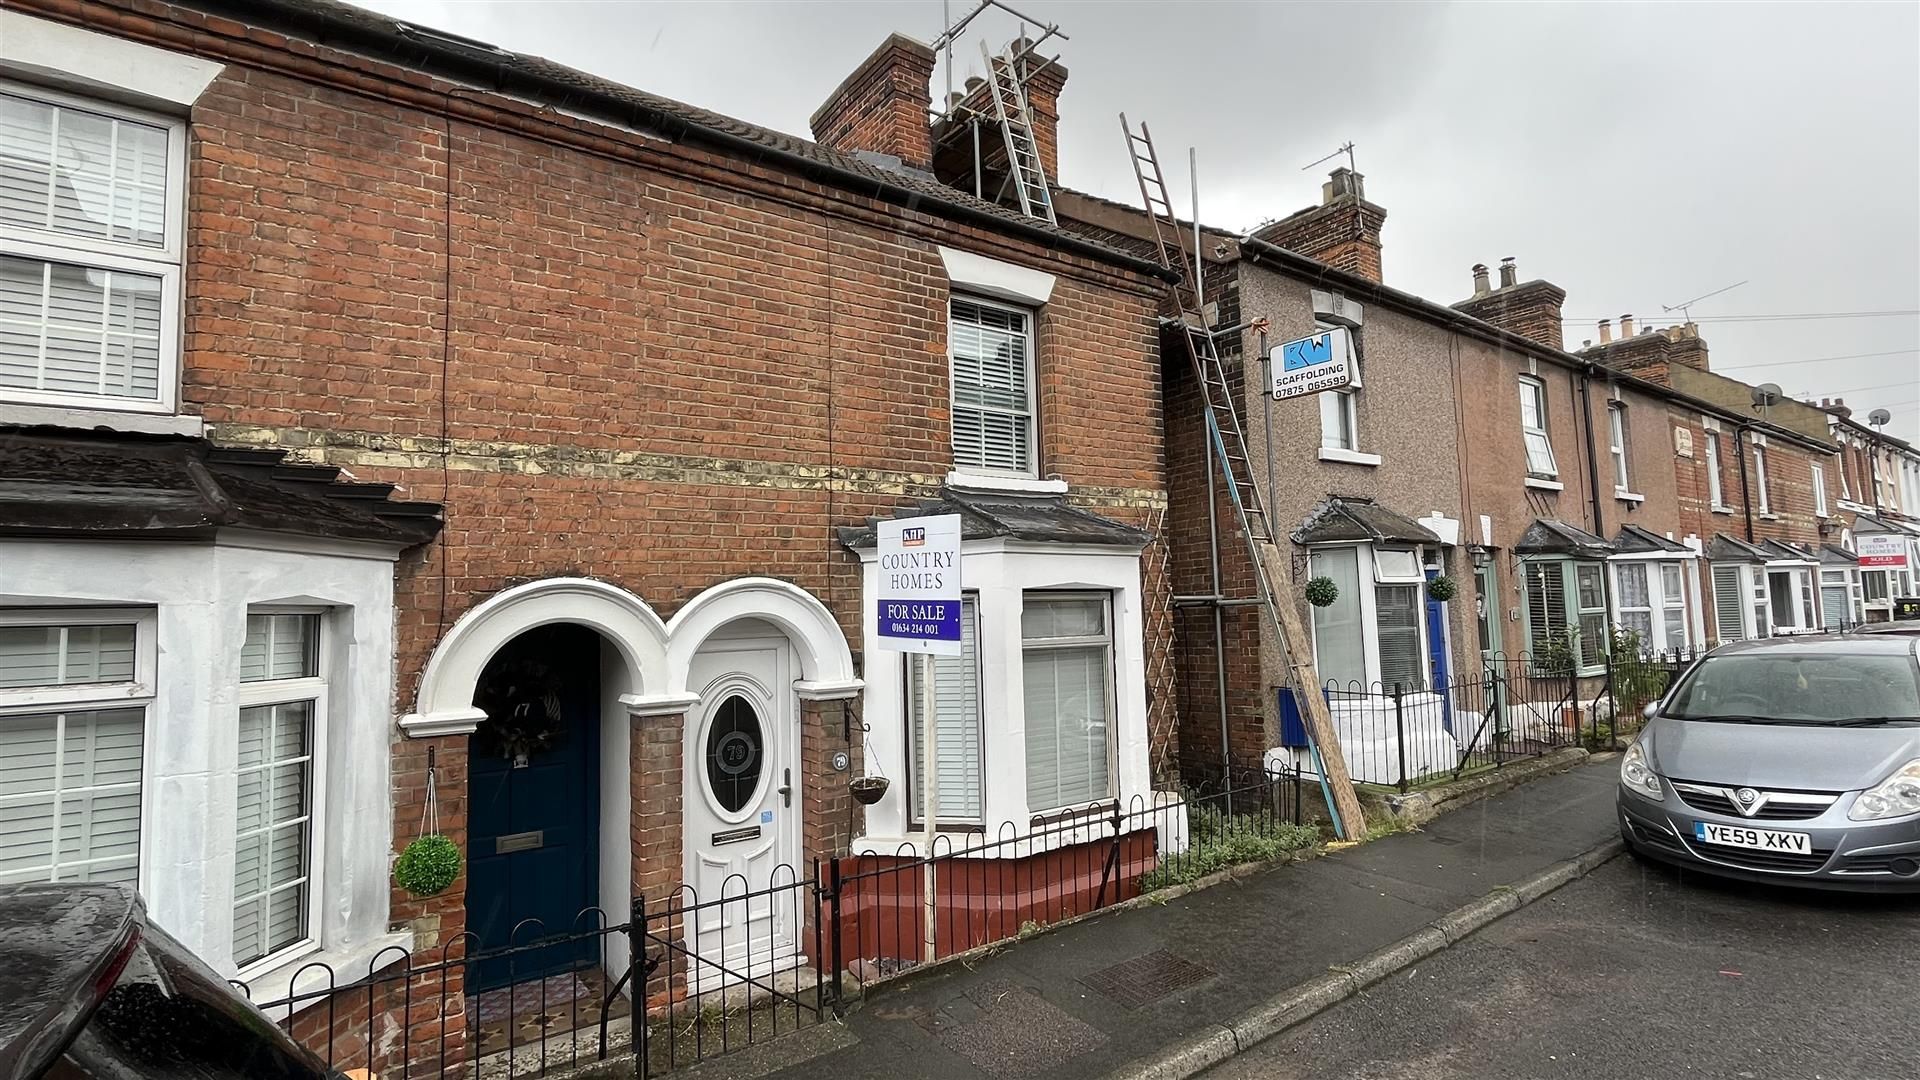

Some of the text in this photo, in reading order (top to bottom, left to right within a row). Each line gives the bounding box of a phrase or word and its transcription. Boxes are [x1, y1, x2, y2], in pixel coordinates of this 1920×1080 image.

[1276, 364, 1344, 387] SCAFFOLDING
[1275, 375, 1346, 398] 07875 065599
[882, 551, 955, 570] COUNTRY
[891, 572, 943, 590] HOMES
[888, 604, 945, 621] FOR SALE
[892, 622, 938, 635] 01634 214 001
[727, 744, 746, 761] 79
[1707, 825, 1804, 850] YE59 XKV
